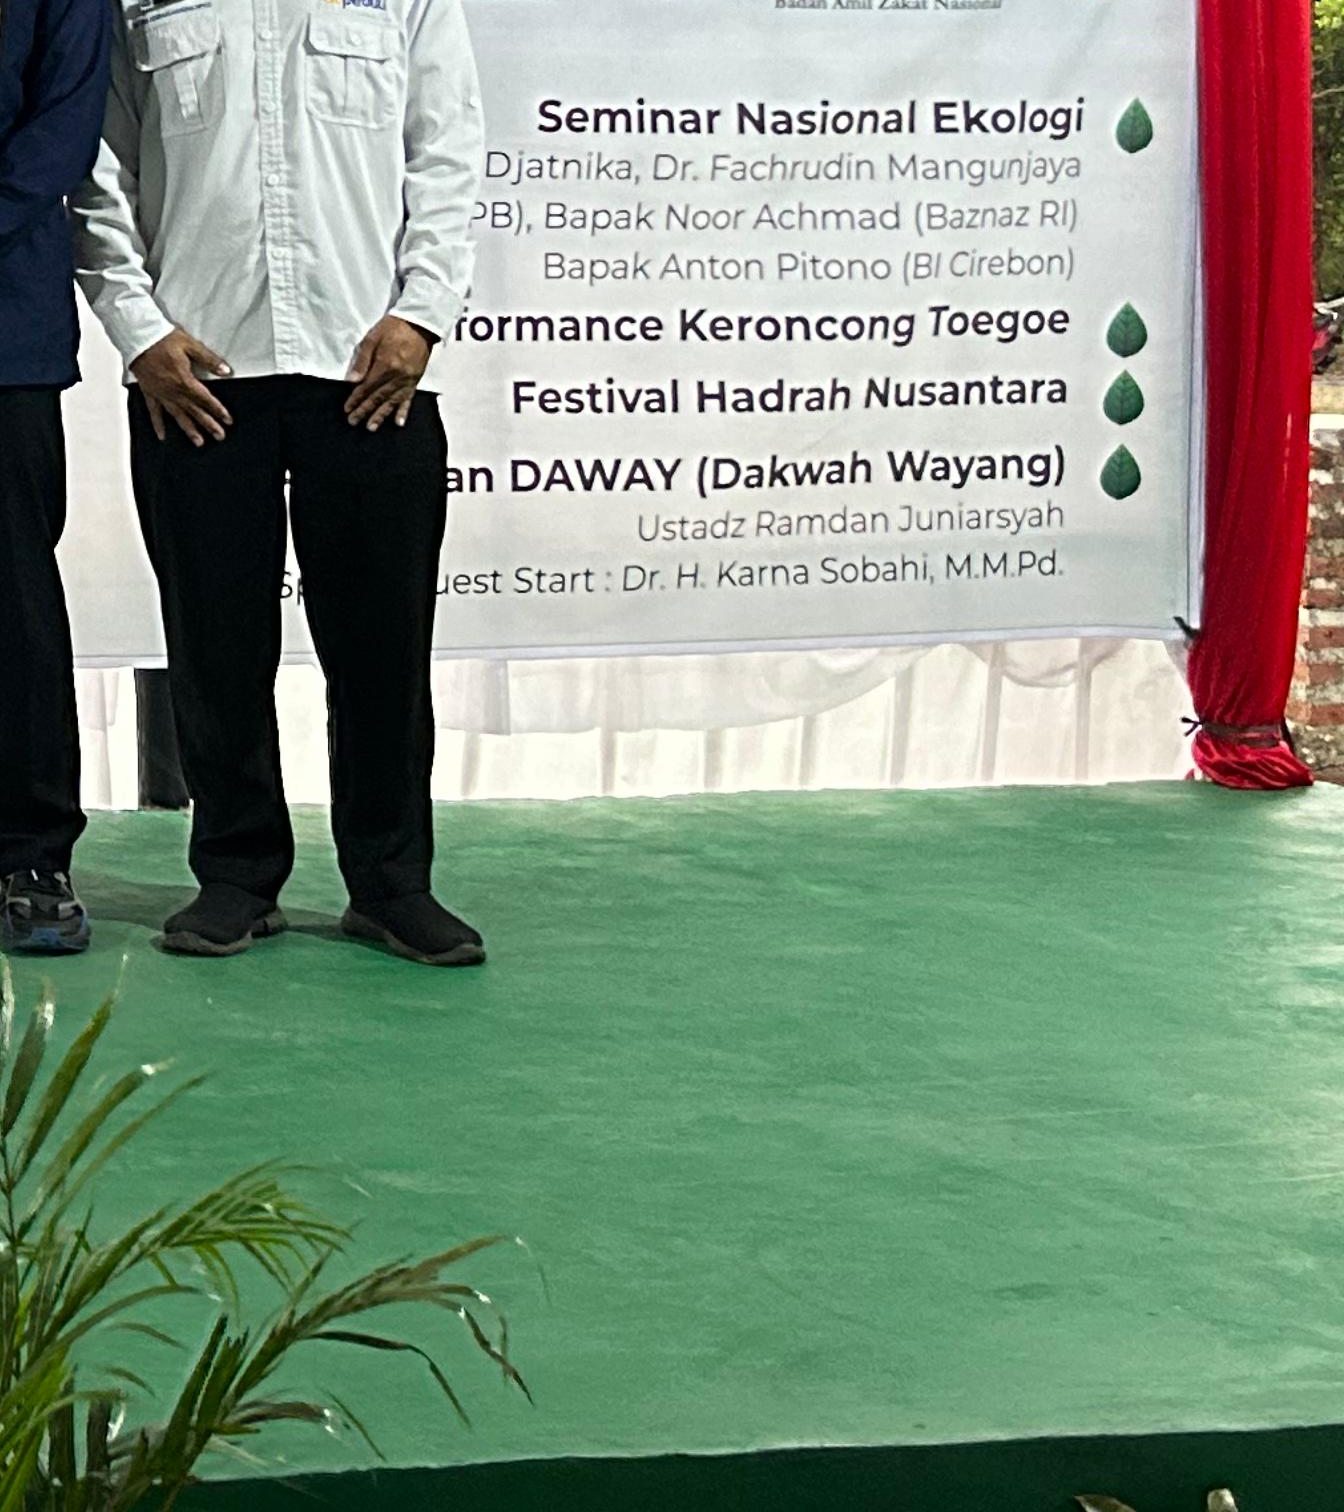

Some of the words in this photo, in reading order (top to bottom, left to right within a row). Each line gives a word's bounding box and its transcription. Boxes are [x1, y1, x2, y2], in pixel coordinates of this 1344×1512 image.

[537, 97, 722, 135] Seminar
[737, 99, 916, 135] Nasional
[933, 96, 1085, 141] Ekologi
[485, 149, 641, 187] Djatnika,
[652, 152, 701, 182] Dr.
[711, 151, 876, 182] Fachrudin
[887, 149, 1082, 187] Mangunjaya
[544, 200, 656, 238] Bapak
[664, 202, 746, 232] Noor
[752, 201, 901, 232] Achmad
[914, 199, 1030, 238] (Baznaz
[1039, 197, 1079, 234] RI)
[543, 250, 652, 288] Bapak
[658, 251, 764, 282] Anton
[776, 251, 893, 281] Pitono
[902, 250, 942, 287] (BI
[949, 244, 1075, 282] Cirebon)
[679, 309, 916, 348] Keroncong
[928, 304, 1071, 344] Toegoe
[512, 376, 679, 414] Festival
[696, 376, 851, 414] Hadrah
[863, 374, 1068, 409] Nusantara
[510, 457, 683, 494] DAWAY
[696, 450, 873, 499] (Dakwah
[887, 444, 1066, 489] Wayang)
[637, 509, 746, 542] Ustadz
[755, 503, 889, 537] Ramdan
[897, 499, 1065, 536] Juniarsyah
[512, 566, 596, 595] Start
[622, 564, 666, 593] Dr.
[676, 562, 707, 590] H.
[717, 560, 810, 589] Karna
[819, 551, 935, 586] Sobahi,
[945, 547, 1064, 580] M.M.Pd.
